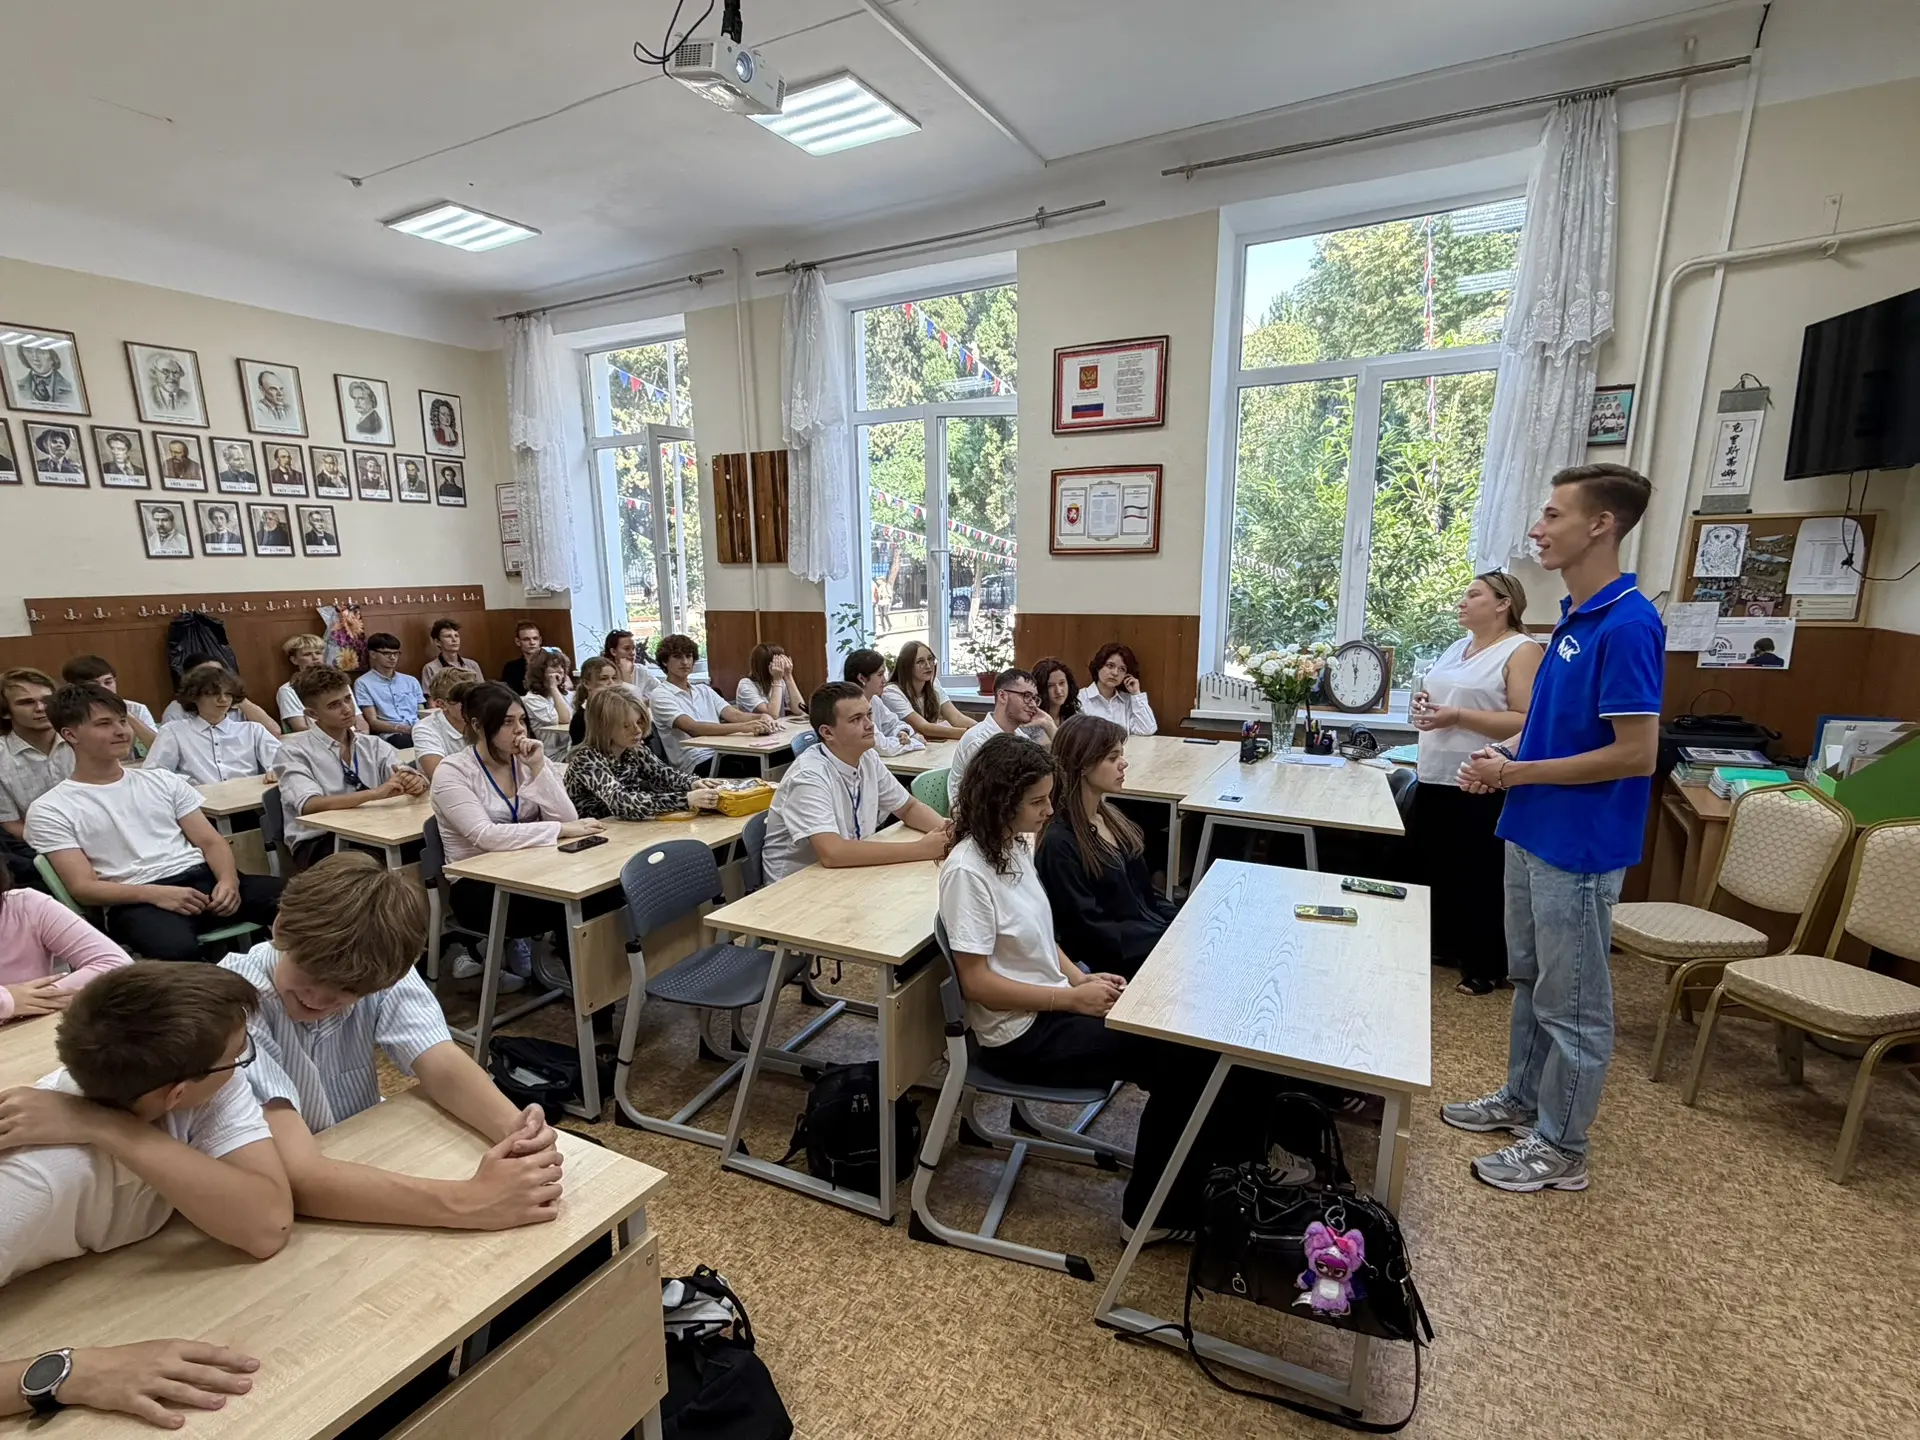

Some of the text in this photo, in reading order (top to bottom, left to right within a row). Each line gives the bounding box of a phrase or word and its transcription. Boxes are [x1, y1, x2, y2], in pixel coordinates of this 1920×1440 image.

[1353, 648, 1362, 656] 12
[1333, 683, 1340, 691] 8
[1371, 683, 1376, 691] 4
[1530, 1160, 1550, 1174] N
